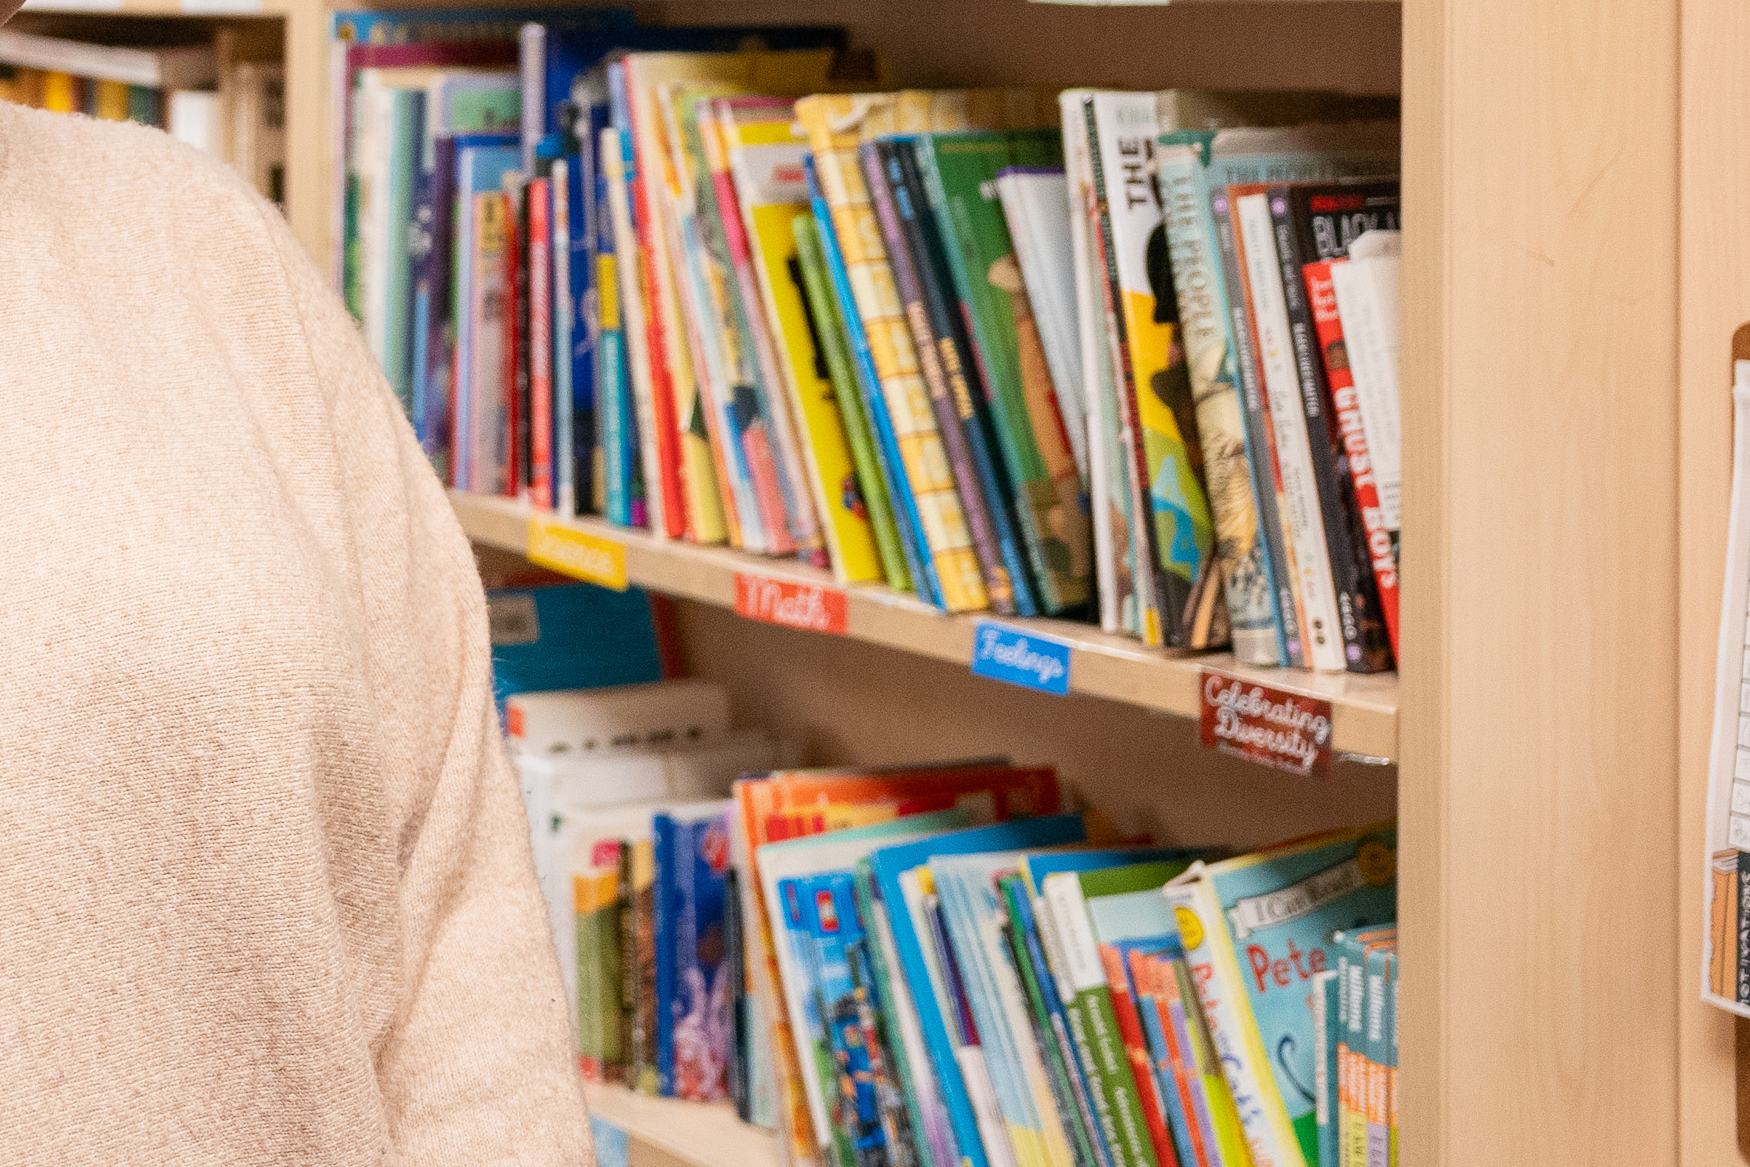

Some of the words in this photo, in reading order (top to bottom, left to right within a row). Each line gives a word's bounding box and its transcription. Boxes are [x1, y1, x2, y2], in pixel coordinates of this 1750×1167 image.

[1118, 137, 1147, 211] THE
[1184, 235, 1216, 340] PEOPLE
[1361, 503, 1396, 589] BOYS
[744, 579, 830, 629] Math
[981, 634, 1066, 684] Feelings
[1204, 674, 1331, 745] Celebrating
[1213, 706, 1319, 771] Diversity
[1248, 939, 1327, 993] Pete
